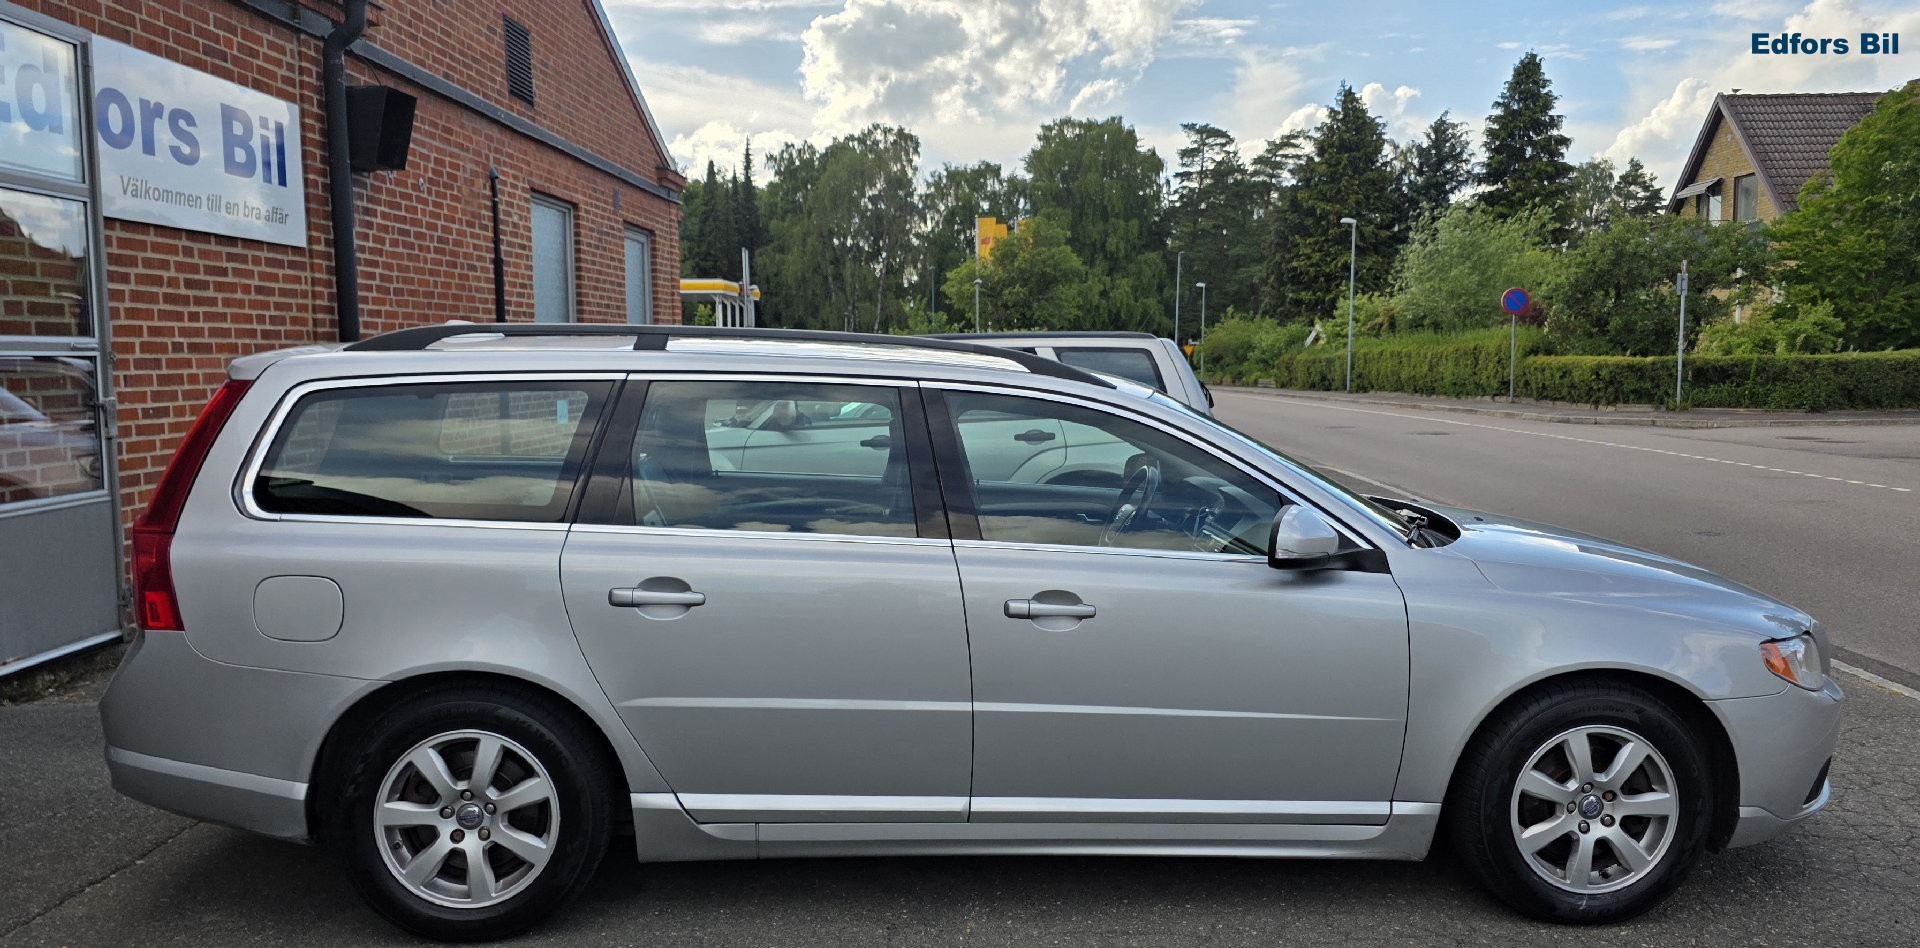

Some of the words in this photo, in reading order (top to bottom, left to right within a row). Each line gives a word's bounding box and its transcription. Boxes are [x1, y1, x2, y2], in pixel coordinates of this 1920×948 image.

[220, 102, 287, 188] Bil
[120, 175, 202, 209] Välkommen
[206, 193, 222, 213] till
[225, 201, 239, 216] en
[243, 200, 261, 220] bra
[264, 206, 289, 225] affär
